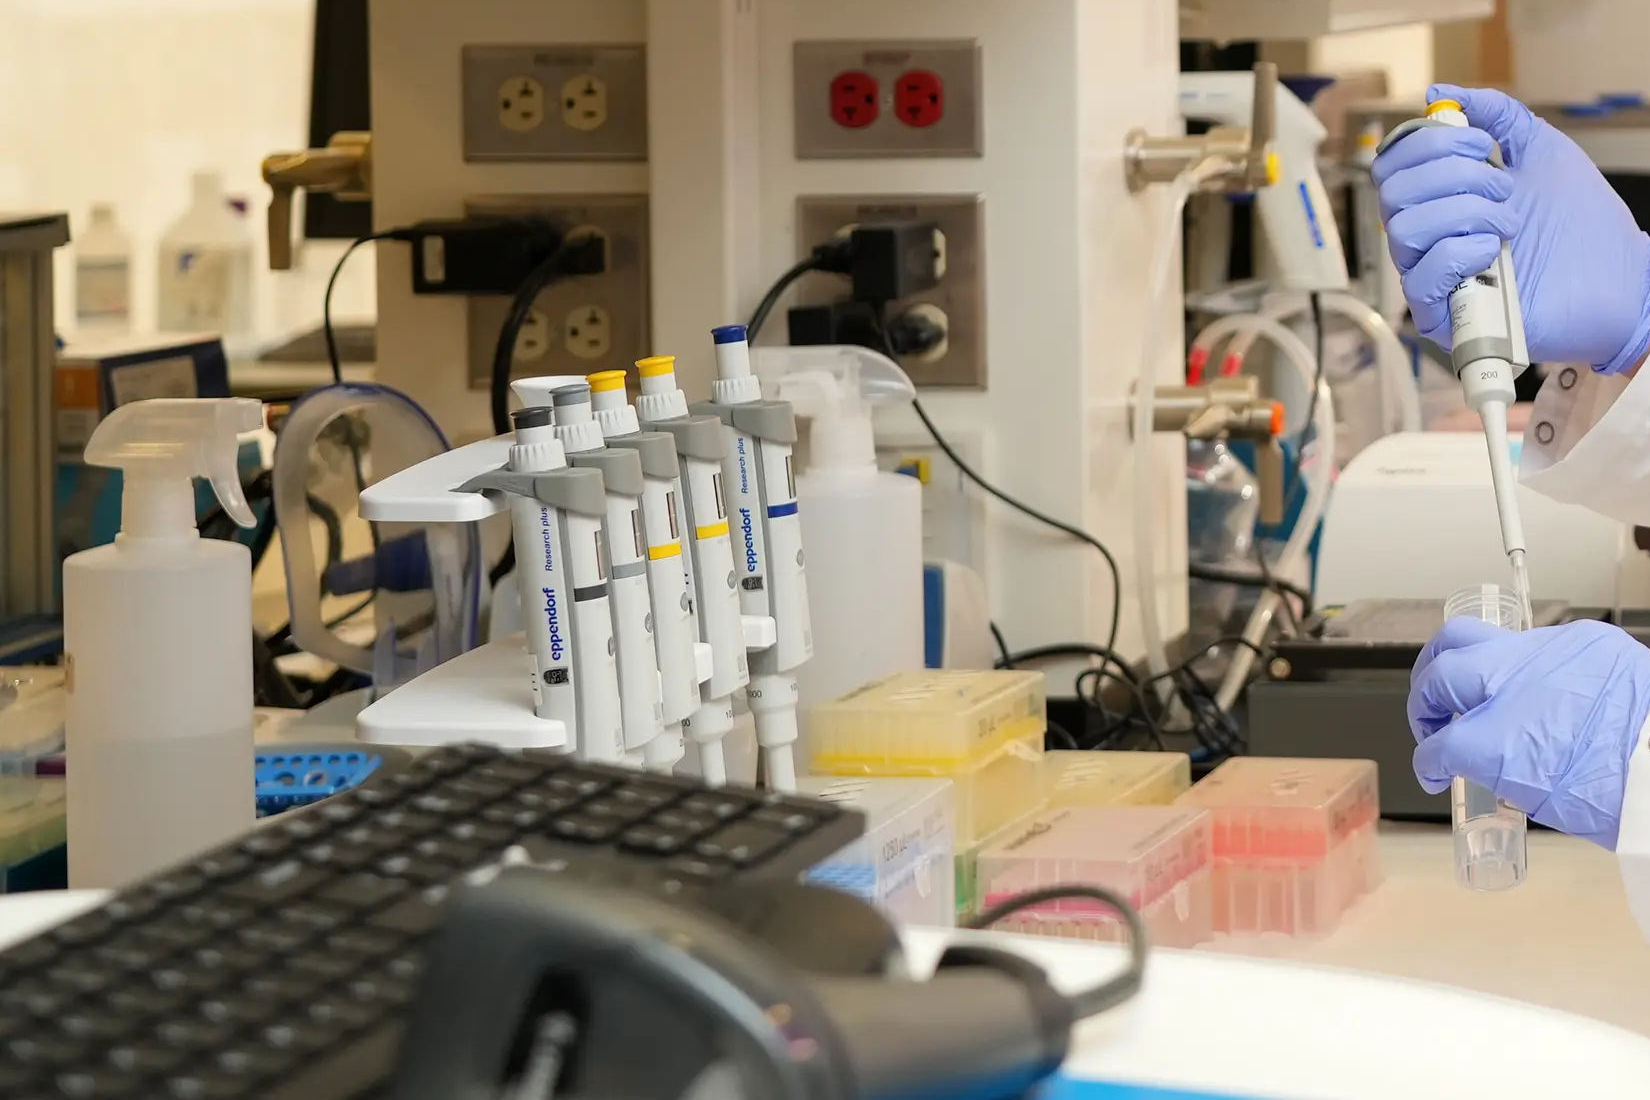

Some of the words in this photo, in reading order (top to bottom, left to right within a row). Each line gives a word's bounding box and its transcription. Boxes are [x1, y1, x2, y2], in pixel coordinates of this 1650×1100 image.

[1480, 370, 1499, 381] 200
[737, 437, 746, 455] plus
[738, 456, 749, 495] Research
[540, 506, 551, 527] plus
[540, 529, 553, 572] Research
[738, 507, 758, 573] eppendorf
[542, 587, 564, 661] eppendorf
